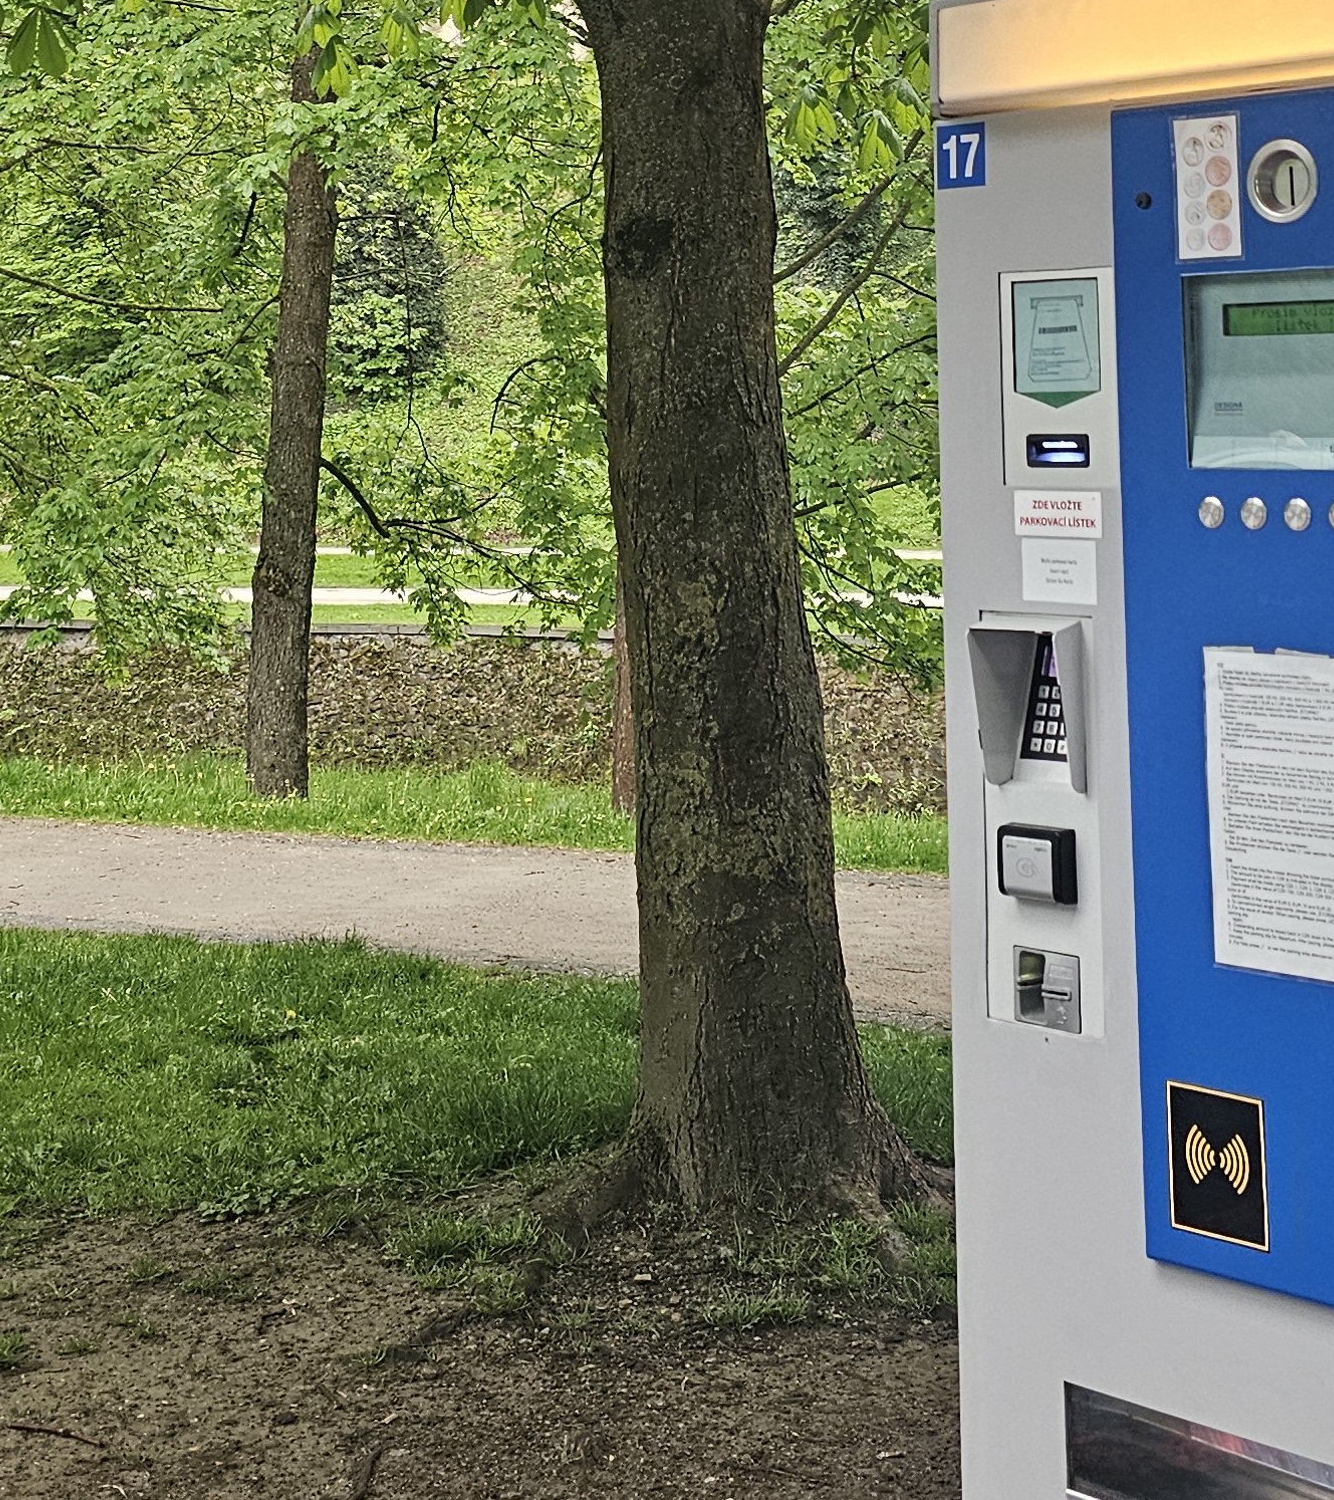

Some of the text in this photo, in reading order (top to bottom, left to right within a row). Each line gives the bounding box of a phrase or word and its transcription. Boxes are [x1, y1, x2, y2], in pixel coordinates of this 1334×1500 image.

[943, 133, 980, 179] 17
[1032, 500, 1082, 511] ZDE VLOŽTE
[1020, 516, 1096, 528] PARKOVACÍ LÍSTEK
